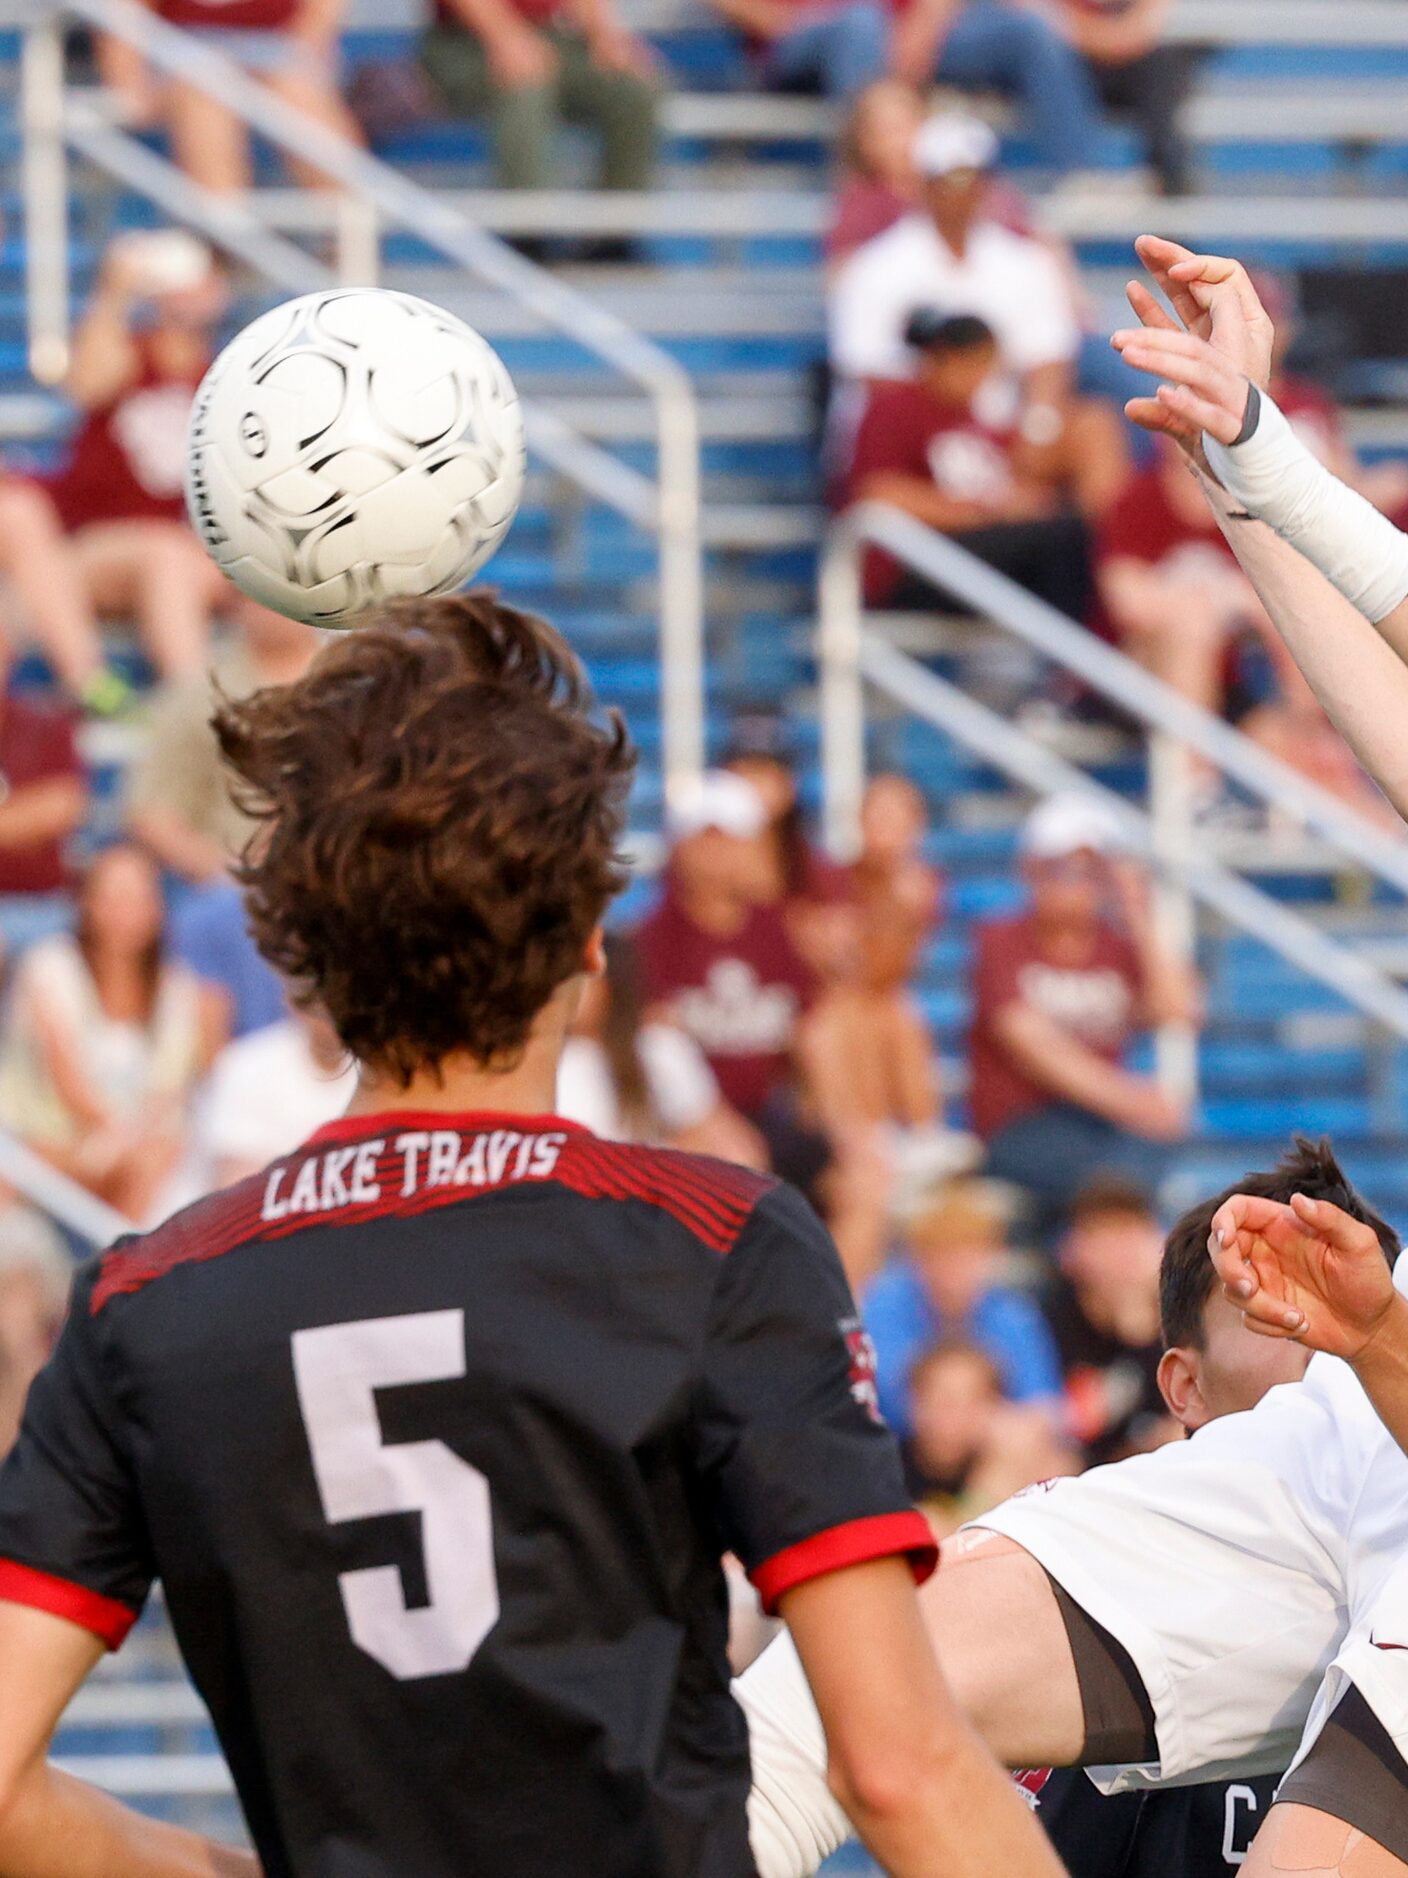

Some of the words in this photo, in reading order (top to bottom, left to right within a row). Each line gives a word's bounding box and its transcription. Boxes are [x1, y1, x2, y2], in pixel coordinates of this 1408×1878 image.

[260, 1139, 386, 1221] LAKE
[395, 1129, 568, 1198] TRAVIS
[291, 1307, 500, 1681] 5
